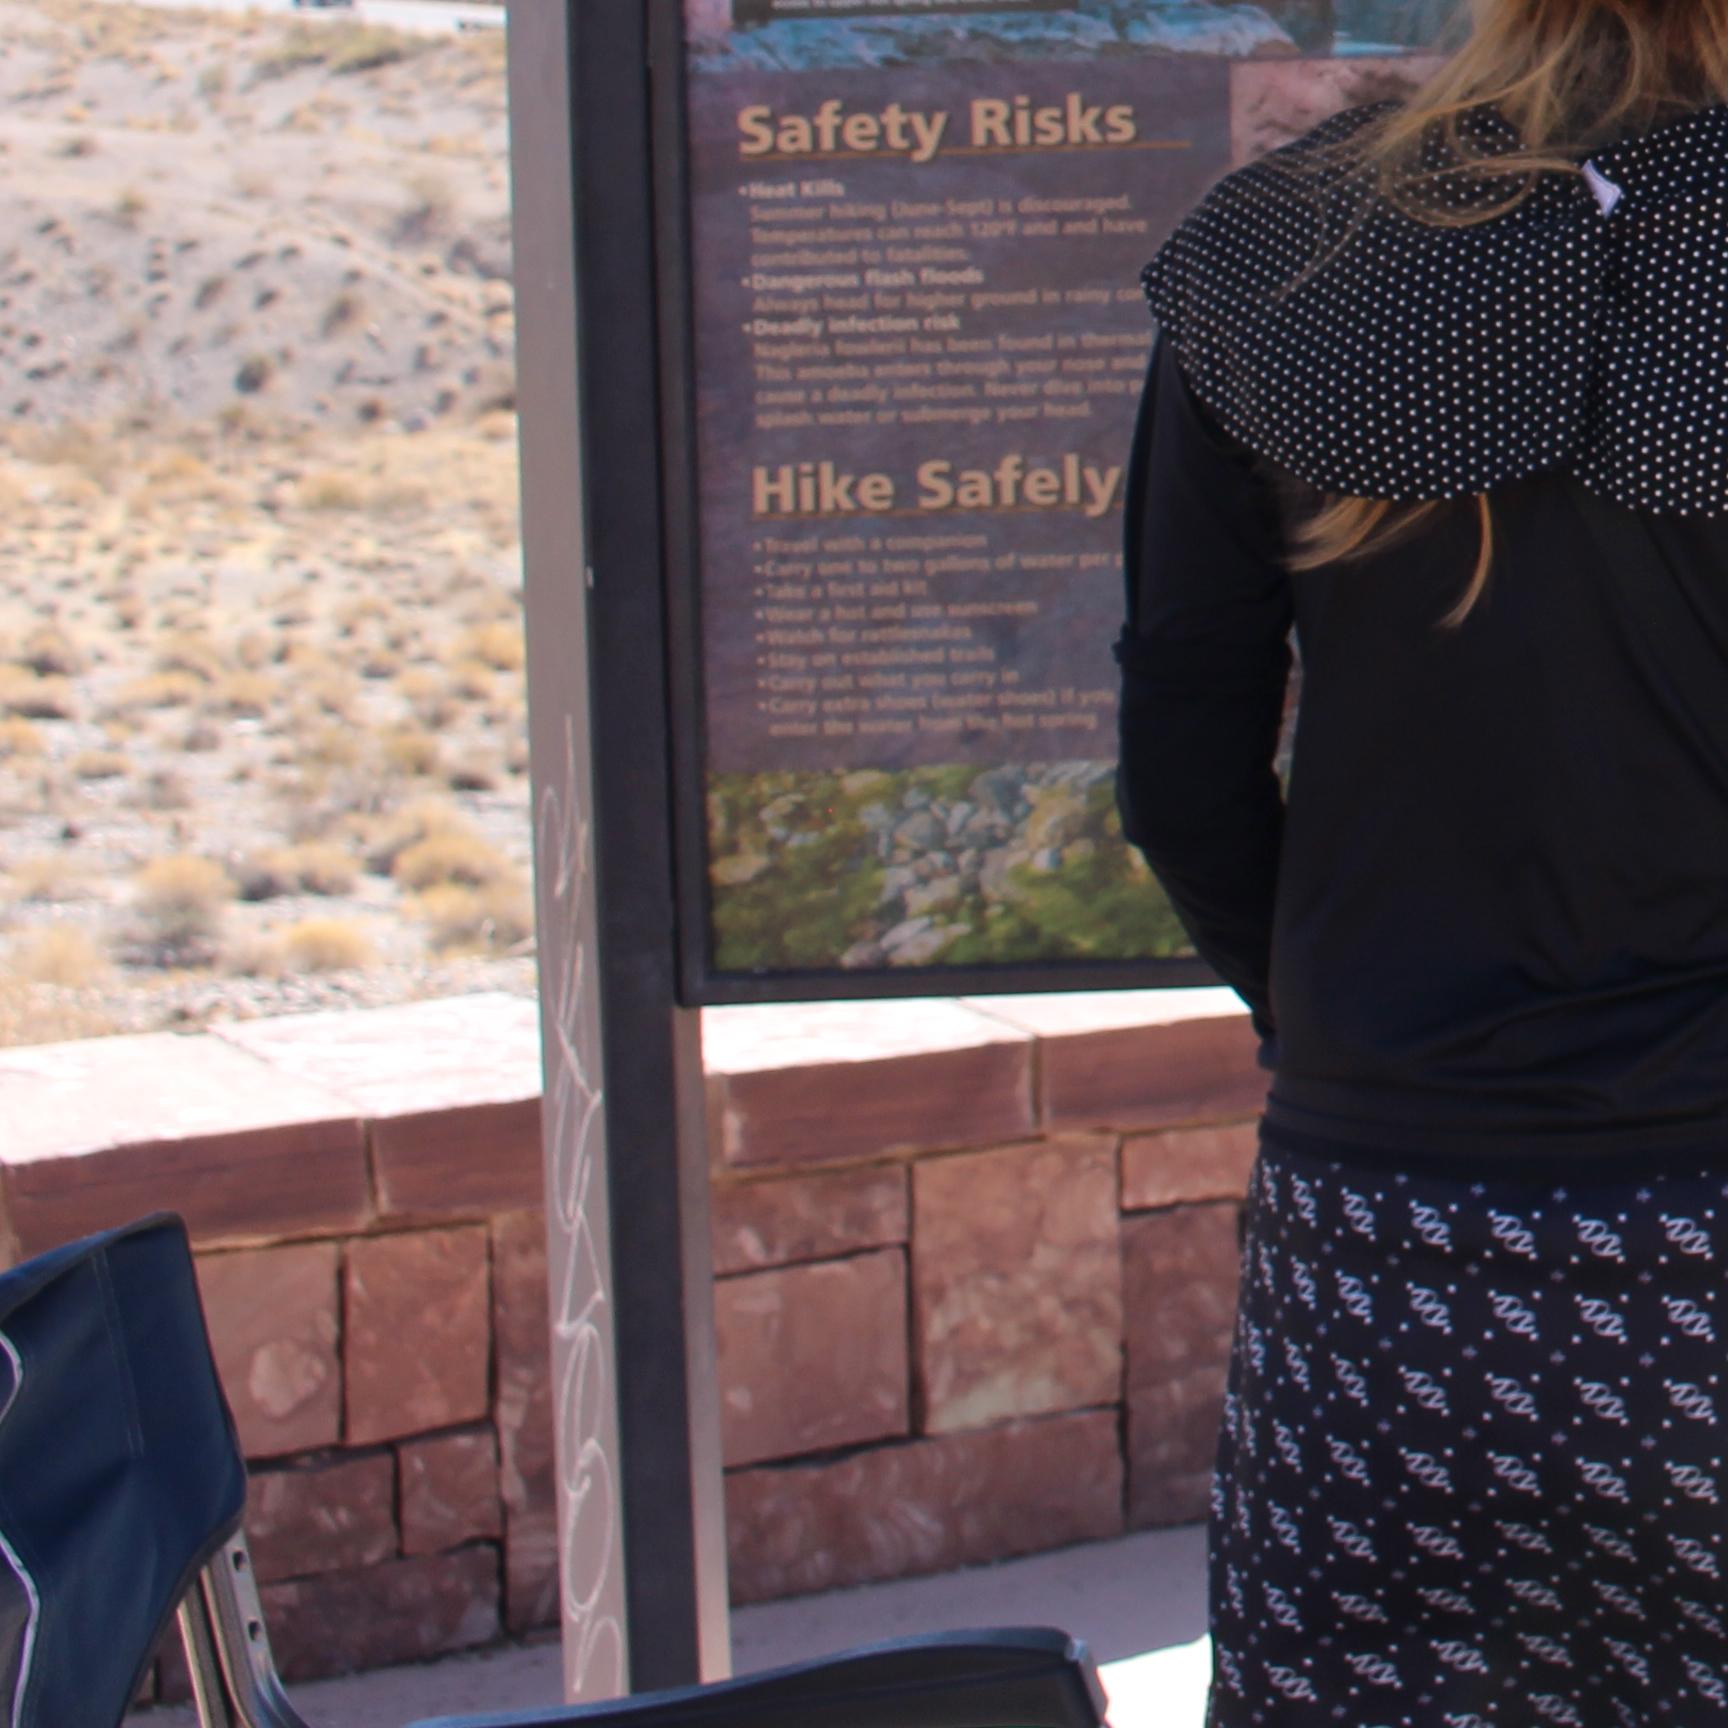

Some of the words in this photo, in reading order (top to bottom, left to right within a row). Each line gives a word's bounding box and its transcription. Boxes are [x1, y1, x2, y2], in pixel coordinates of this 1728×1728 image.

[738, 100, 946, 162] Safety
[970, 93, 1137, 147] Risks
[750, 182, 796, 198] Heat
[800, 178, 846, 197] Kills
[752, 273, 859, 293] Dangerous
[754, 318, 823, 338] Deadly
[827, 314, 919, 334] infection
[923, 311, 960, 331] risk
[752, 460, 895, 514] Hike
[917, 453, 1122, 518] Safely
